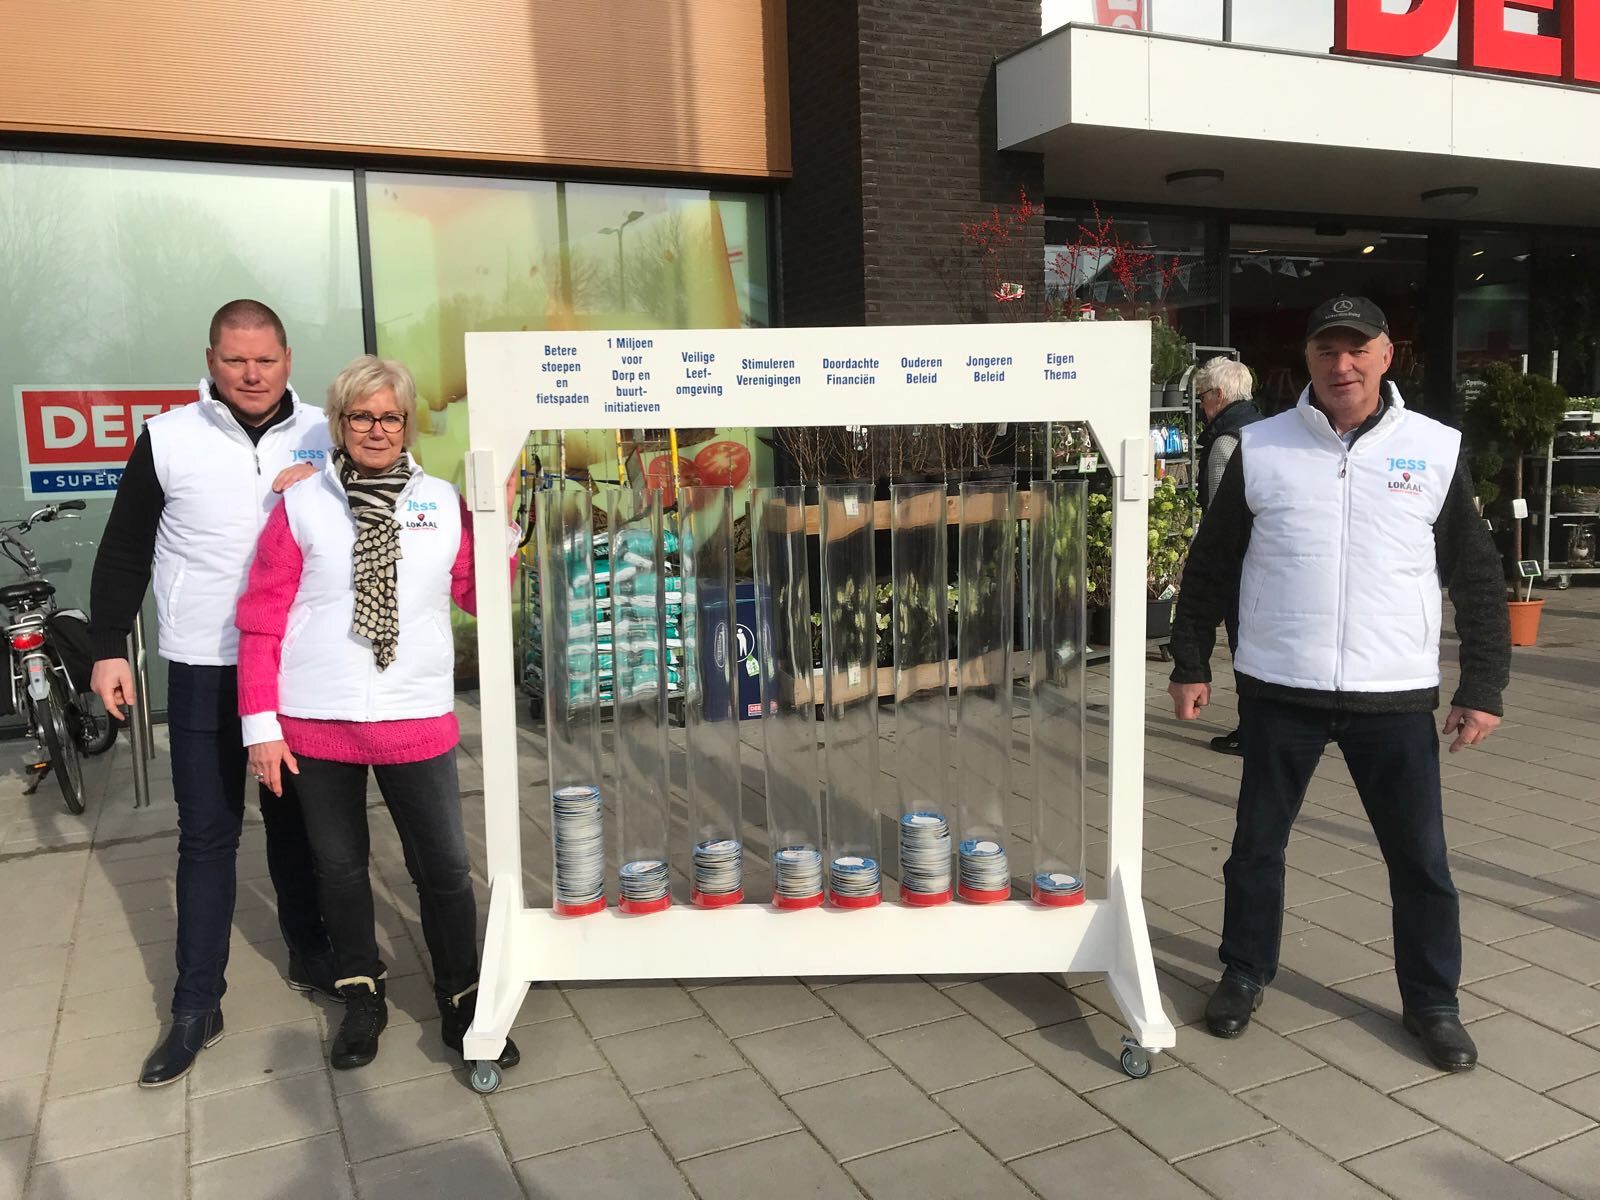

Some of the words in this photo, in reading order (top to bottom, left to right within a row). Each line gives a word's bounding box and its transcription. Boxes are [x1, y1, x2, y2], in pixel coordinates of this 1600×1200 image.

[544, 344, 578, 357] Betere
[606, 337, 612, 349] 1
[616, 337, 654, 351] Miljoen
[621, 355, 643, 365] voor
[681, 351, 716, 365] Veilige
[741, 357, 795, 370] Stimuleren
[822, 357, 880, 370] Doordachte
[900, 356, 943, 369] Ouderen
[965, 355, 1013, 369] Jongeren
[1046, 352, 1075, 367] Eigen
[541, 361, 582, 375] stoepen
[685, 367, 712, 379] Leef-
[611, 369, 636, 384] Dorp
[638, 371, 651, 381] en
[735, 373, 801, 388] Verenigingen
[826, 373, 876, 385] Financiën
[906, 372, 938, 384] Beleid
[973, 370, 1005, 383] Beleid
[1043, 369, 1077, 381] Thema
[555, 379, 569, 388] en
[675, 383, 723, 397] omgeving
[615, 385, 648, 397] buurt-
[535, 392, 590, 407] fietspaden
[604, 401, 661, 413] initiatieven
[56, 474, 122, 487] SUPER
[1388, 481, 1423, 493] LOKAAL
[406, 521, 438, 529] LOKAAL
